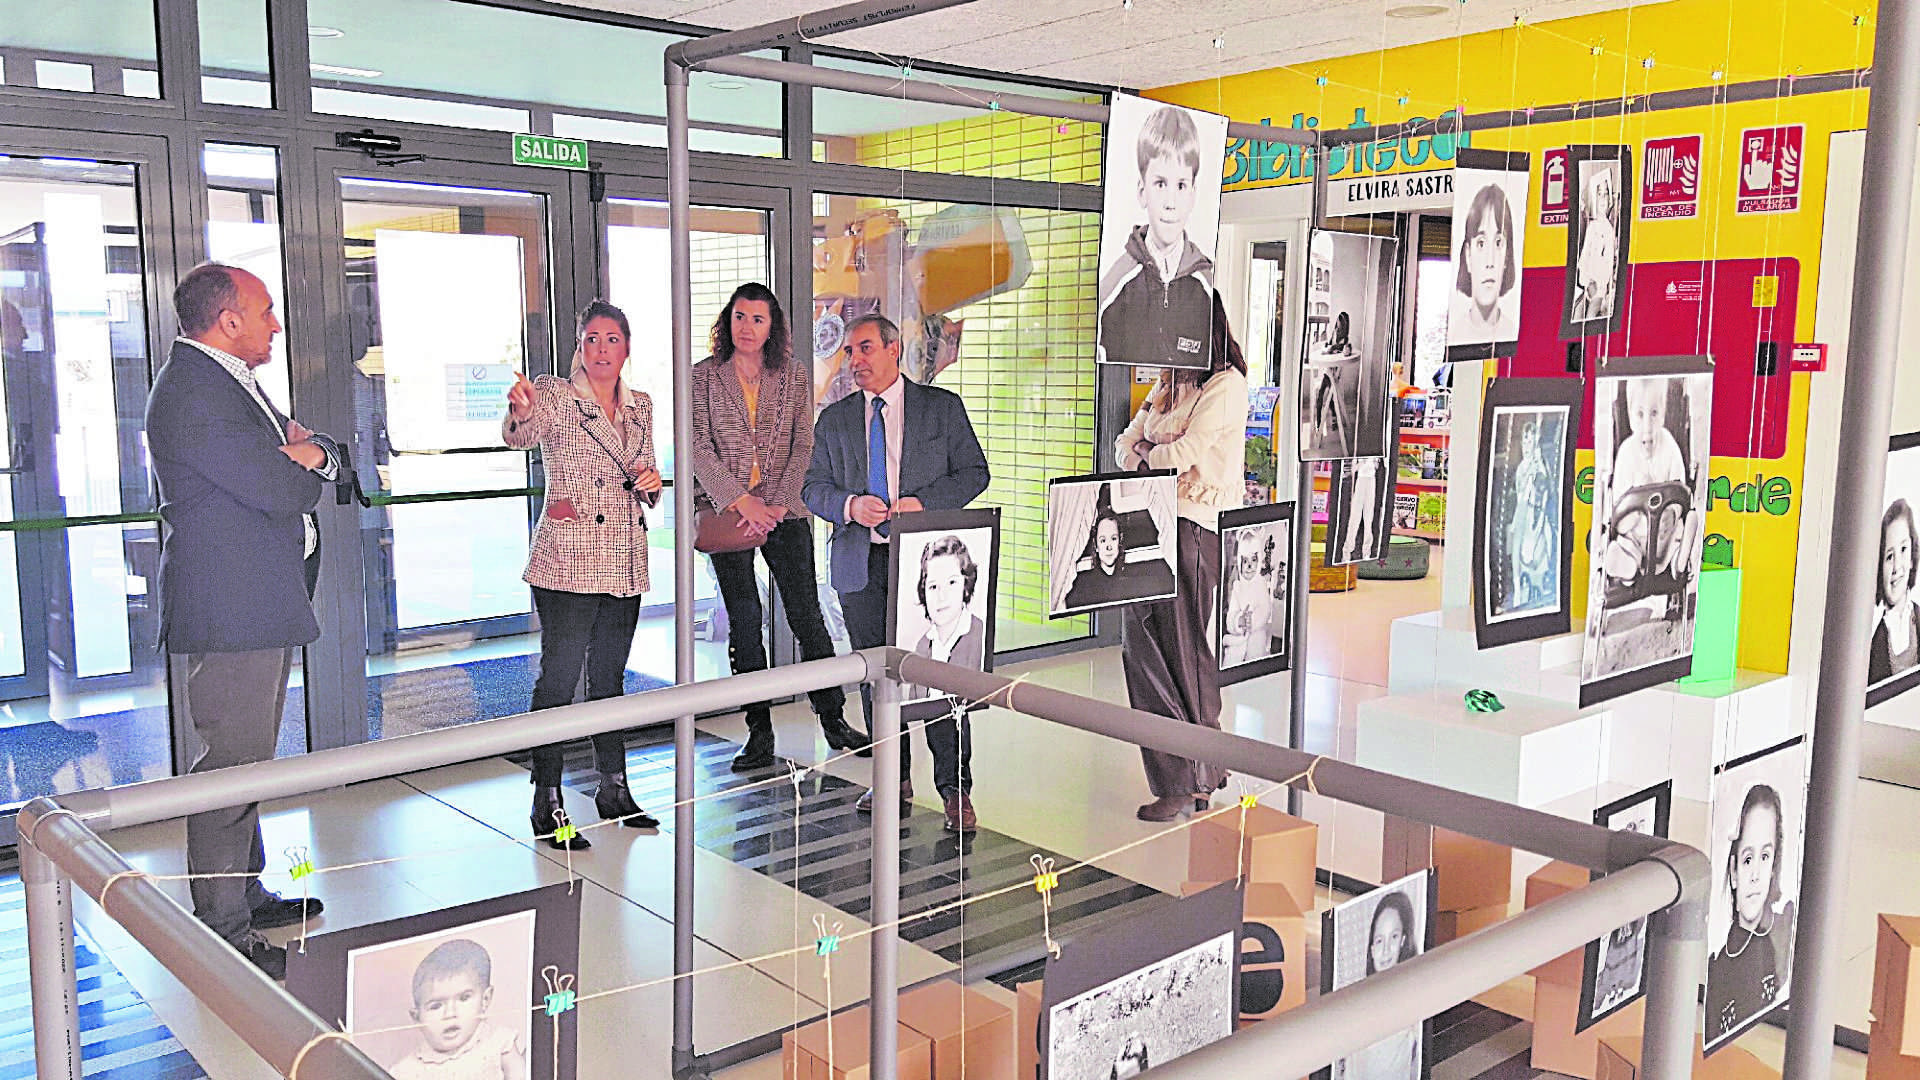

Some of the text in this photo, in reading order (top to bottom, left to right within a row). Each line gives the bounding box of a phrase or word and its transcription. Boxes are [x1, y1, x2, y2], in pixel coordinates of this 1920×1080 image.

[520, 139, 582, 162] SALIDA
[1348, 174, 1454, 202] ELVIRA SASTR
[1644, 209, 1692, 218] INCENDIO
[1645, 205, 1673, 213] BOCA
[1543, 214, 1569, 223] EXTIN
